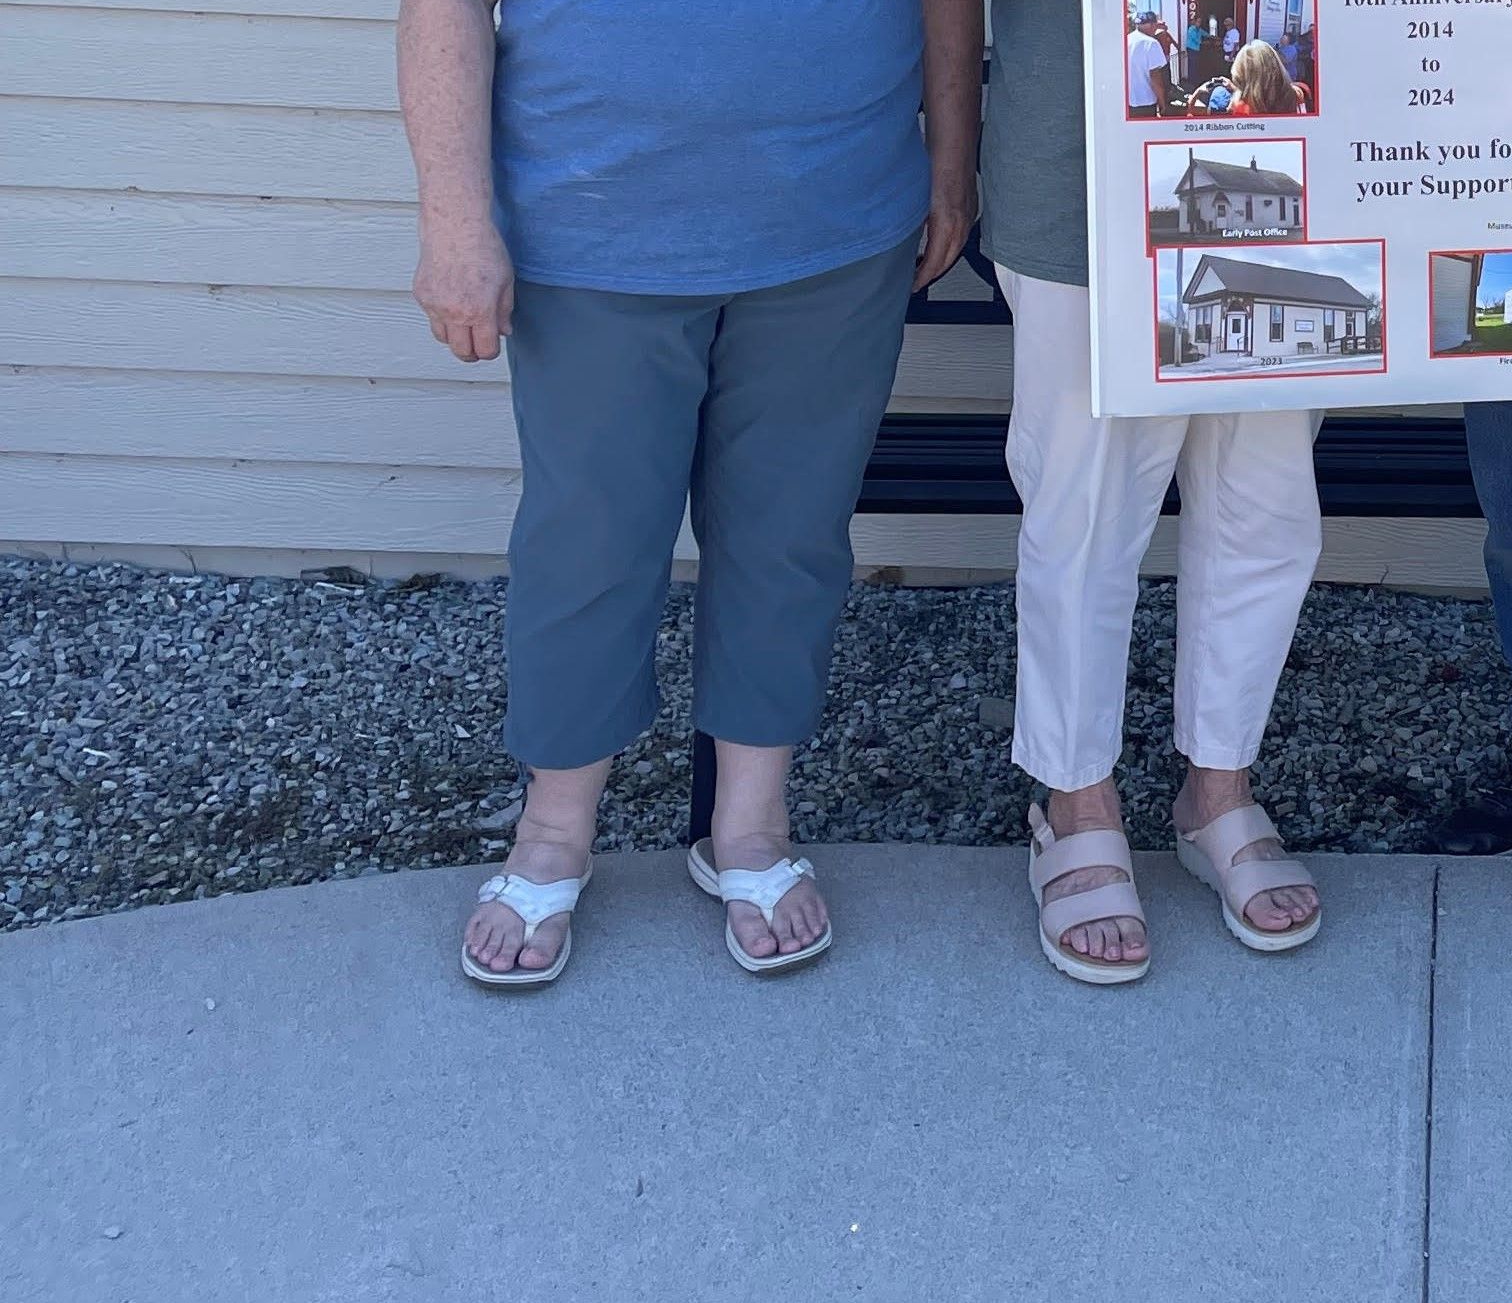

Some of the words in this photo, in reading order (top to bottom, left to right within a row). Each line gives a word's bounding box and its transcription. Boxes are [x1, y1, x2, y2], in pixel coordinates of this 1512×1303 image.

[1407, 21, 1455, 39] 2014
[1421, 57, 1441, 73] to
[1407, 88, 1455, 107] 2024
[1184, 124, 1204, 132] 2014
[1206, 124, 1235, 132] Ribbon
[1236, 123, 1266, 132] Cutting
[1350, 140, 1430, 162] Thank
[1438, 143, 1480, 166] you
[1356, 180, 1413, 203] your
[1222, 229, 1243, 239] Early
[1244, 229, 1263, 237] Post
[1264, 228, 1288, 237] Office
